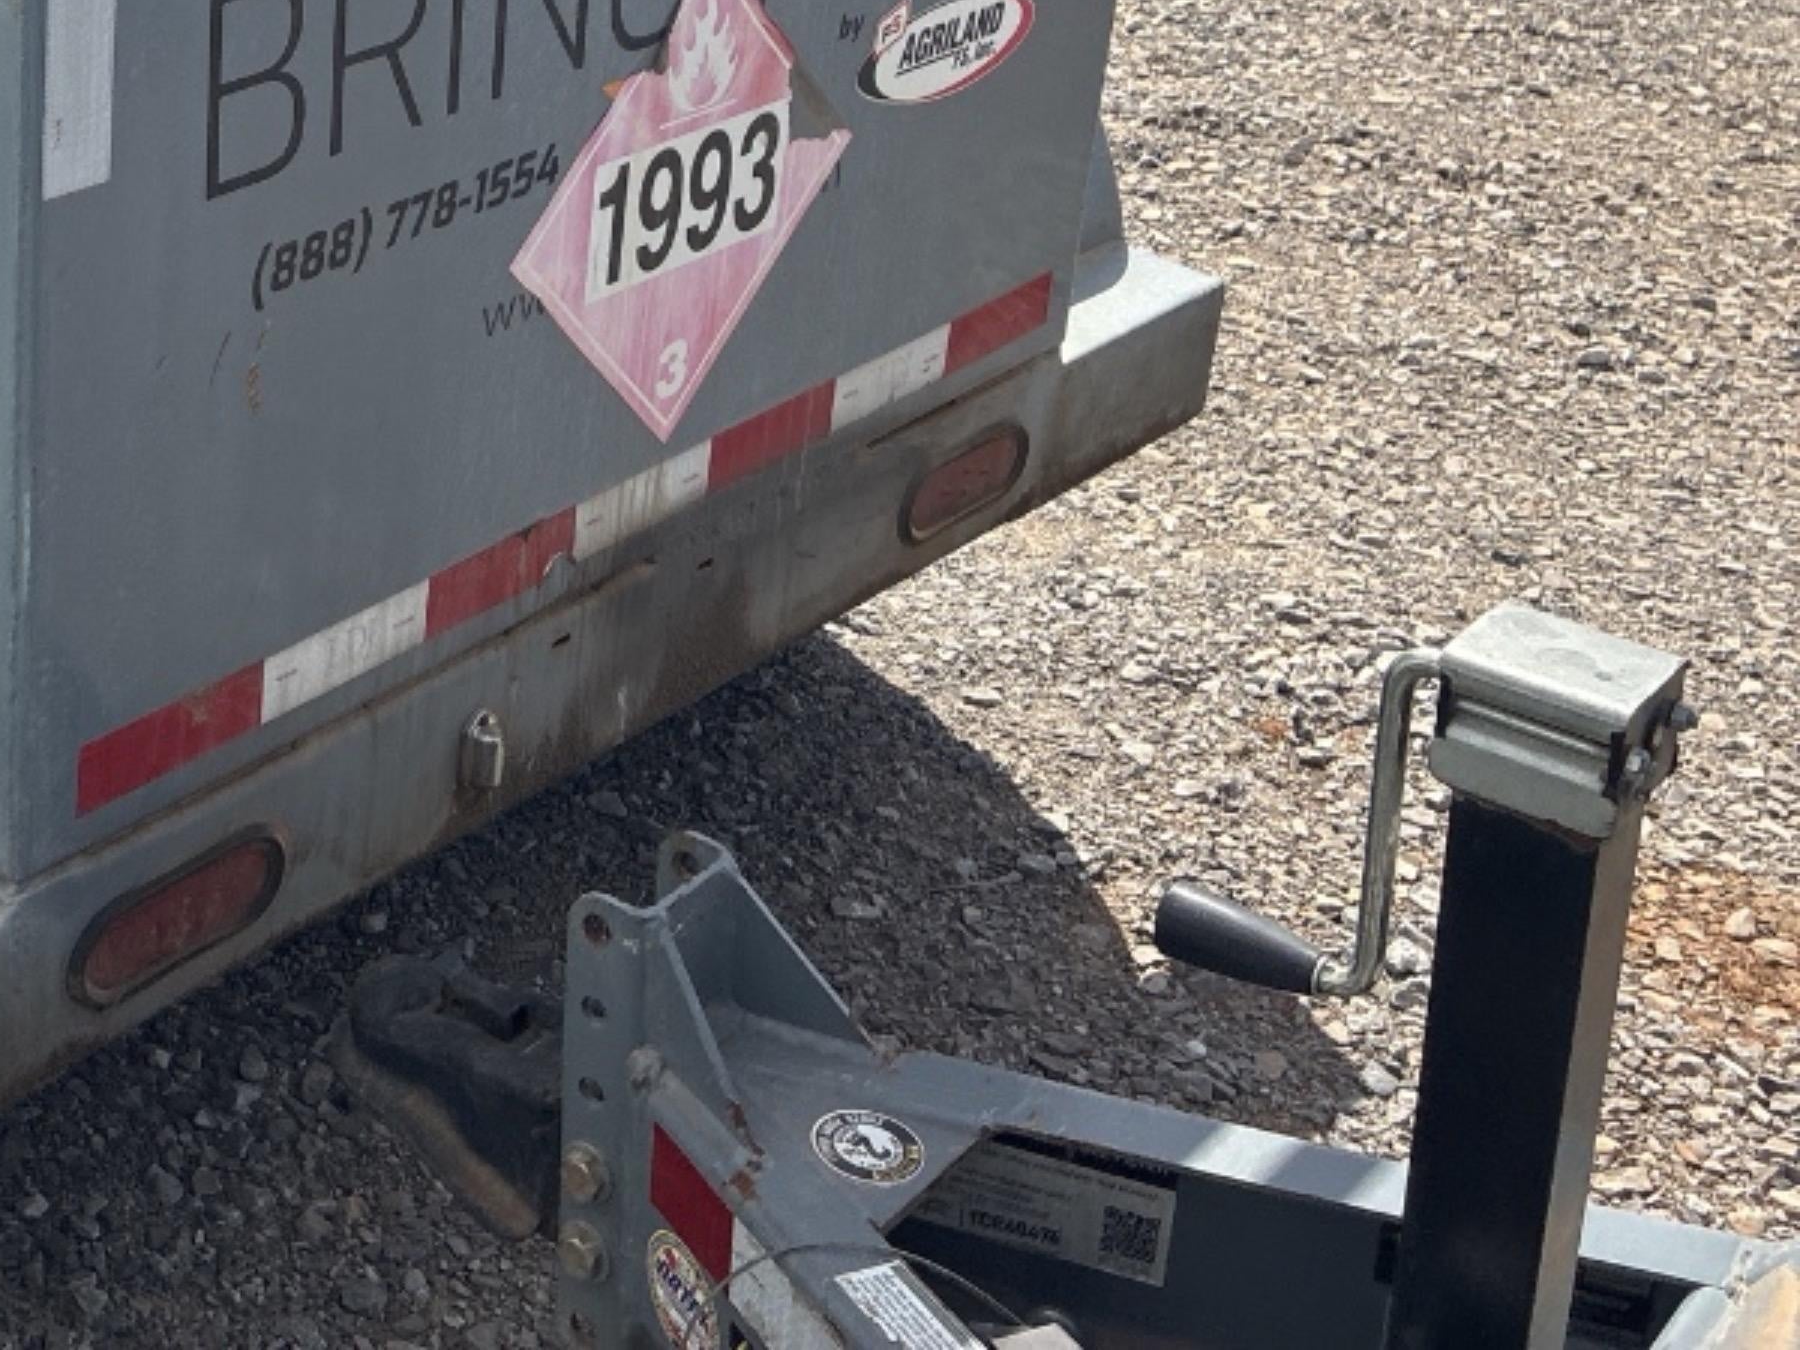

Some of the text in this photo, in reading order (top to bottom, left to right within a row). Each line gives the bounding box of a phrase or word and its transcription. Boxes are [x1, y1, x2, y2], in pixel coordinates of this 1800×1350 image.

[838, 13, 865, 43] by
[897, 0, 1006, 70] AGRILAND
[252, 143, 560, 312] (888) 778-1554
[599, 111, 780, 286] 1993
[655, 338, 689, 399] 3
